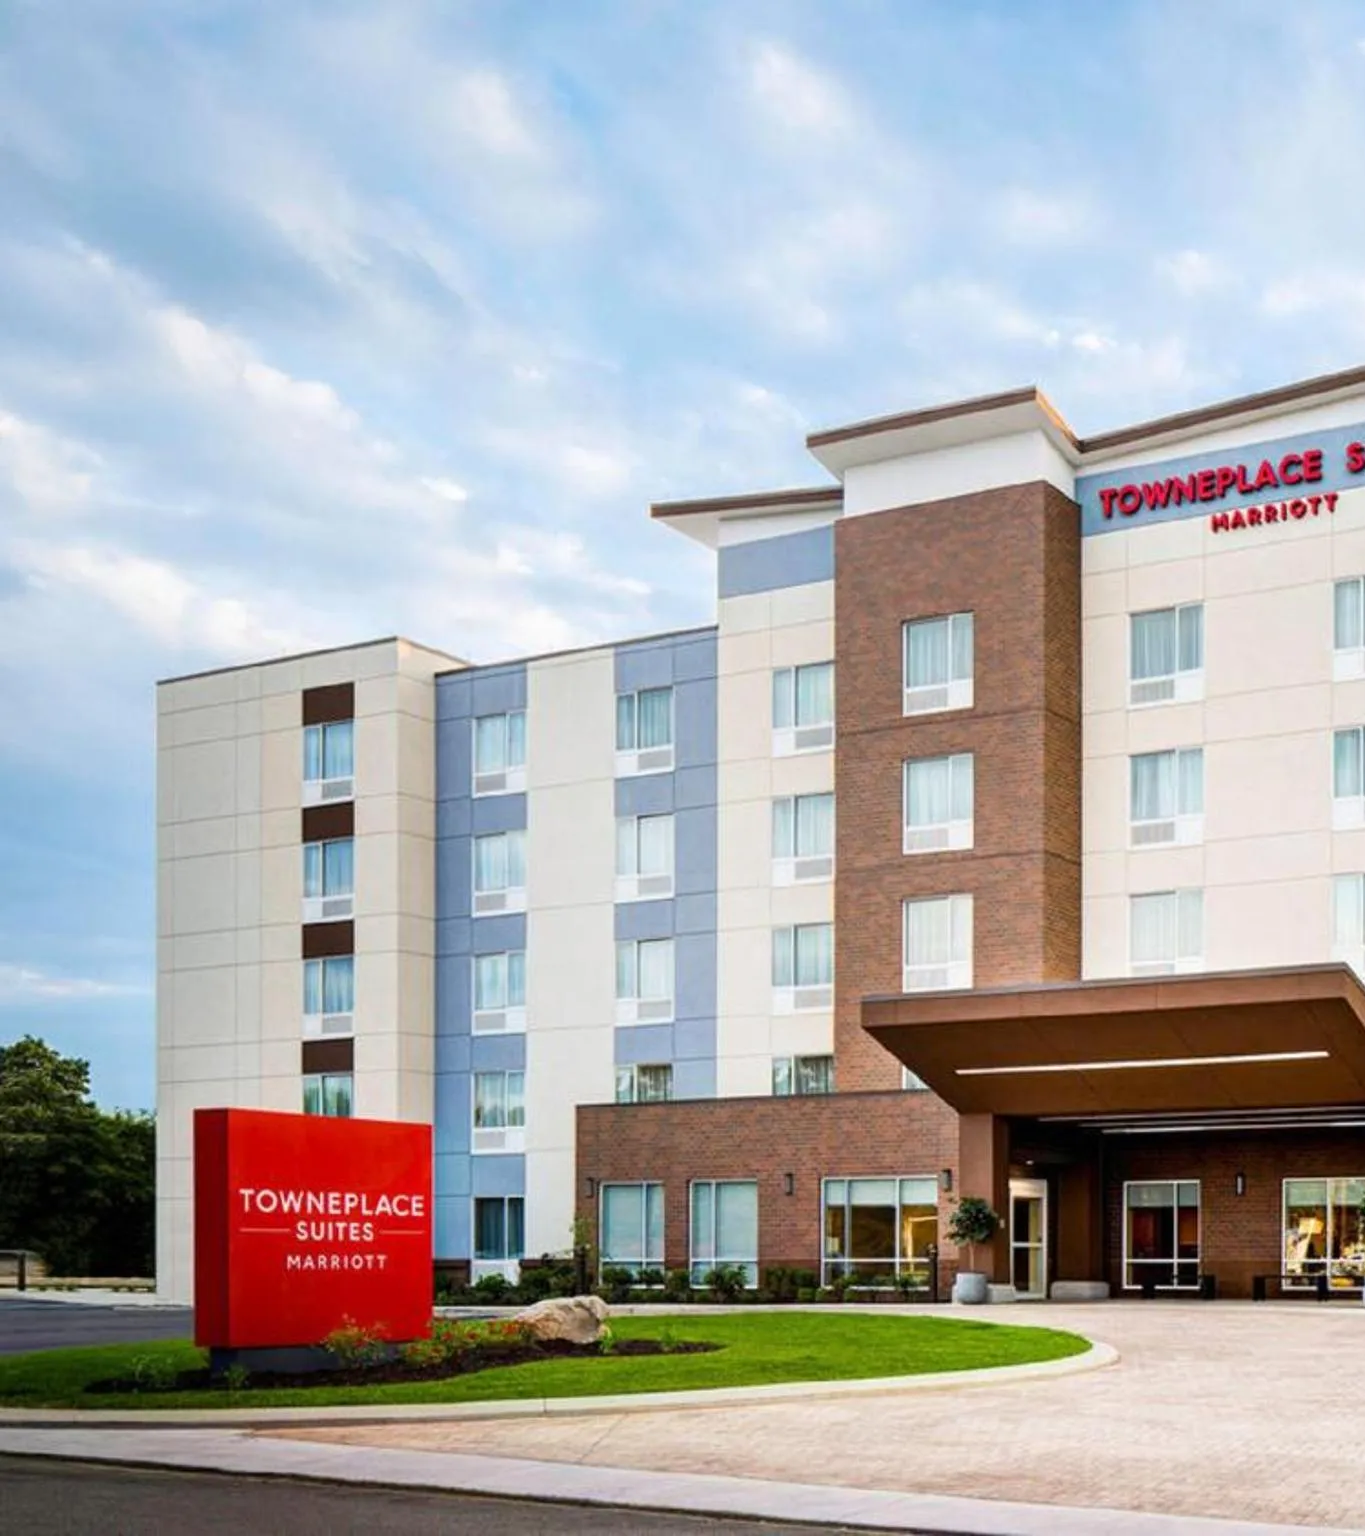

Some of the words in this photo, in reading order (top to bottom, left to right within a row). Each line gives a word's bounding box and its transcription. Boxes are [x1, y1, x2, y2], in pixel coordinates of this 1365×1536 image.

[1099, 449, 1323, 518] TOWNEPLACE
[1211, 493, 1338, 533] MARRIOTT
[239, 1189, 424, 1216] TOWNEPLACE
[296, 1221, 374, 1241] SUITES
[286, 1254, 388, 1270] MARRIOTT
